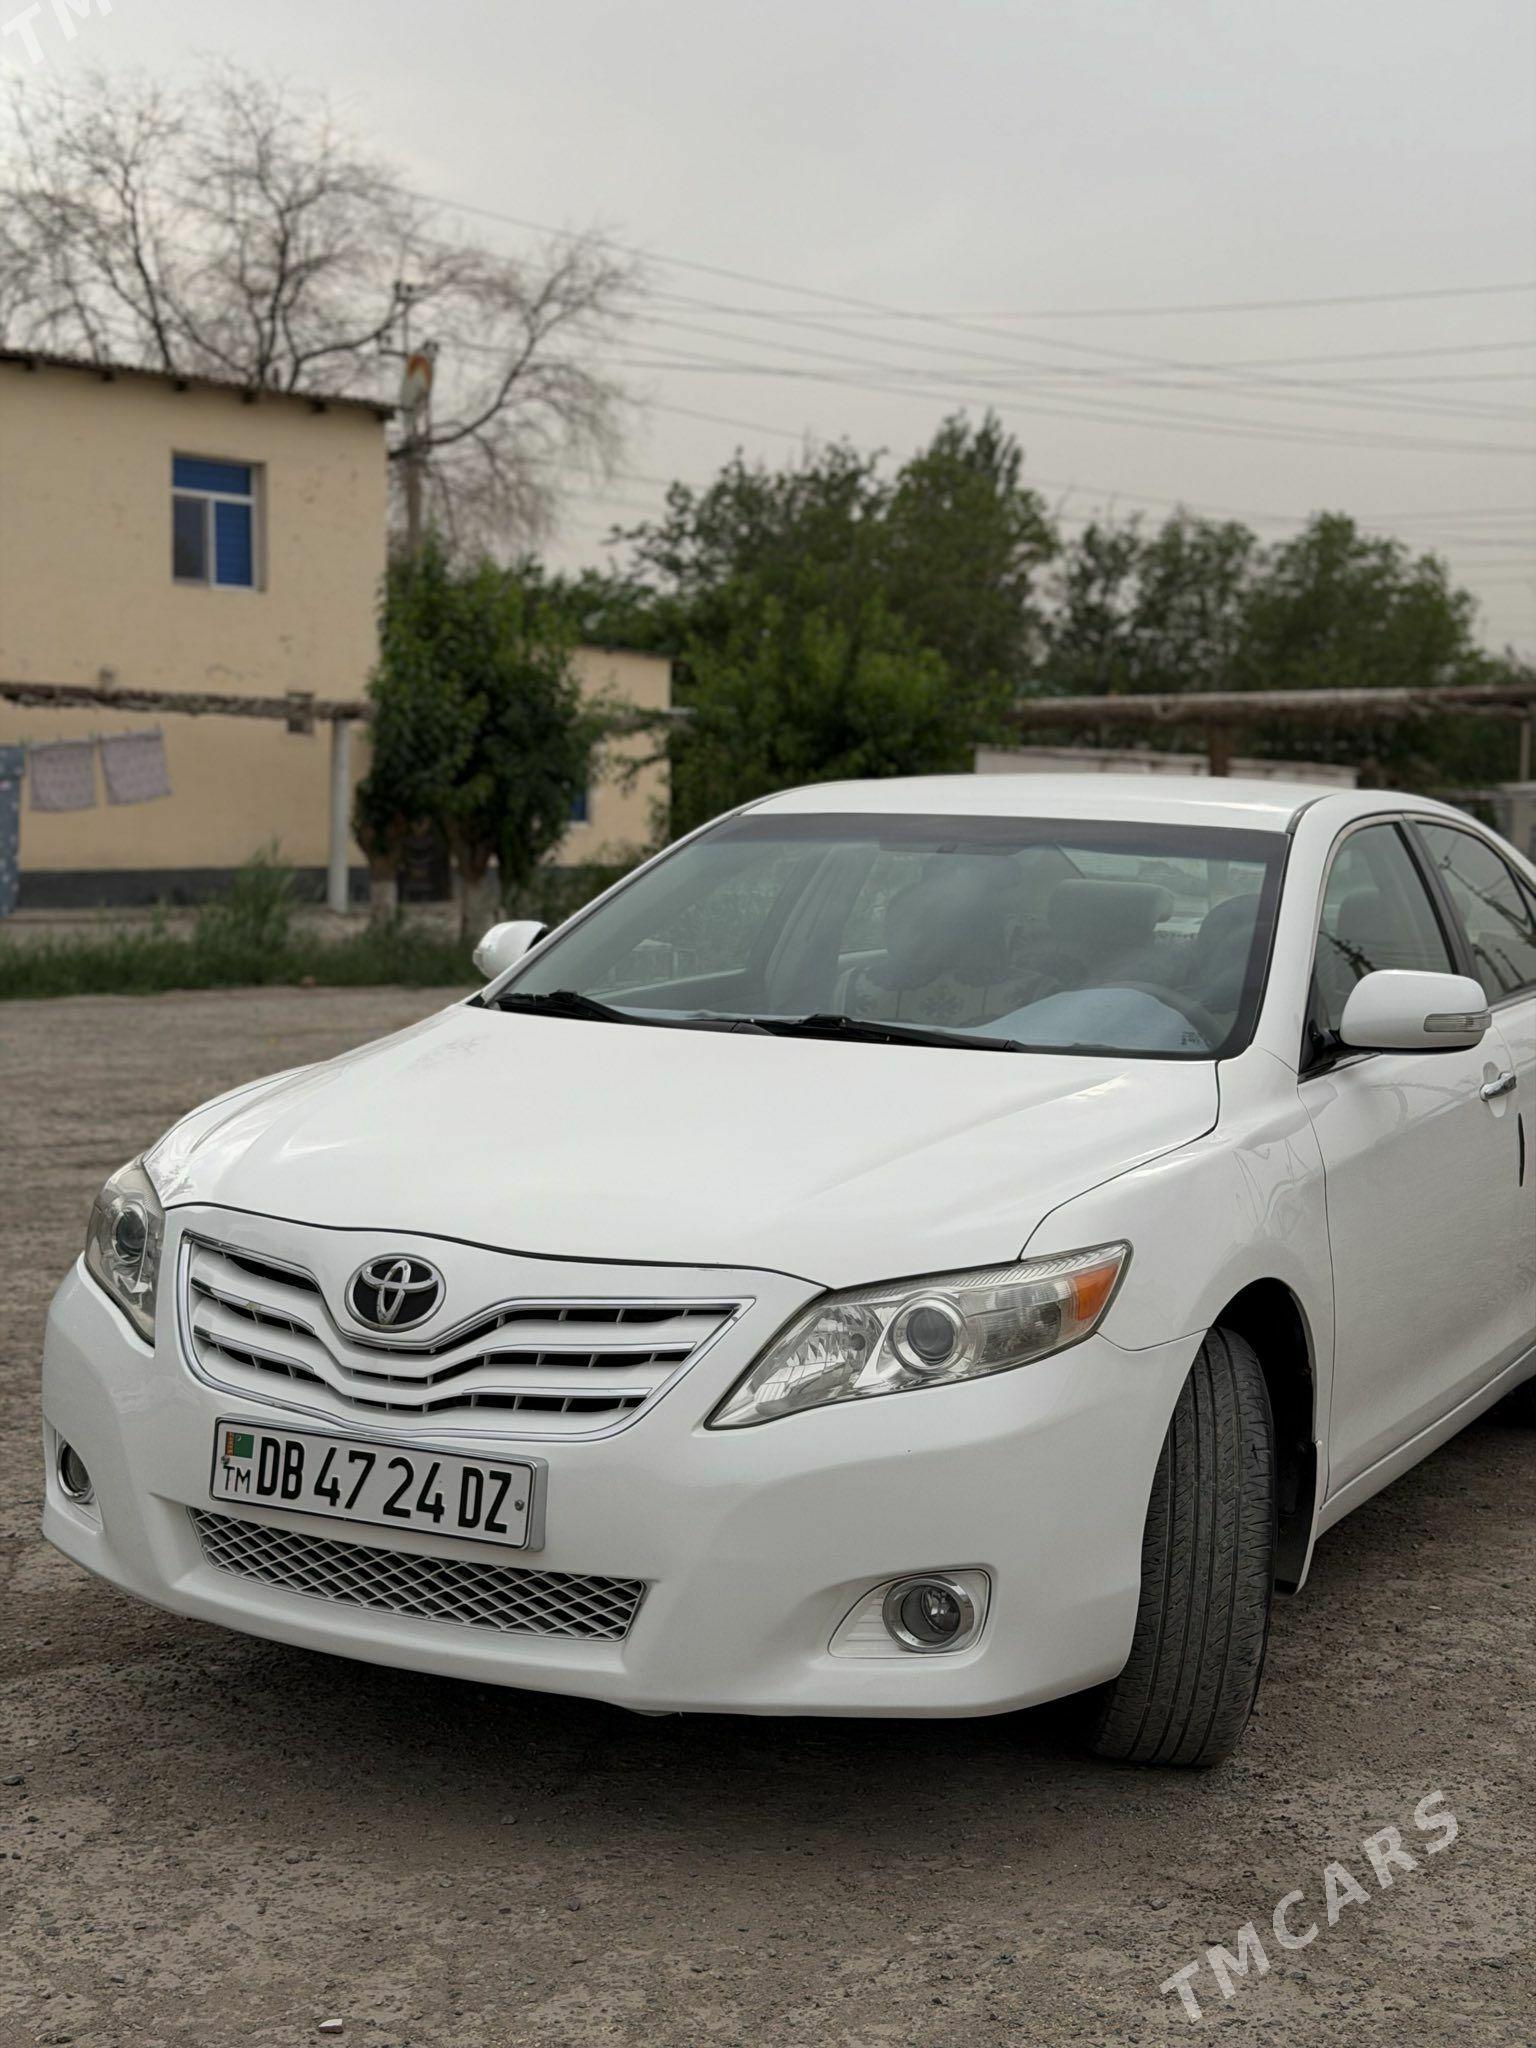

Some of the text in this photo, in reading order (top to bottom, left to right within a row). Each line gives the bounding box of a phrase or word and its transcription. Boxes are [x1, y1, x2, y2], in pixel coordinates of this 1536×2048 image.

[222, 1464, 251, 1494] TM
[256, 1436, 512, 1534] DB 47 24 DZ
